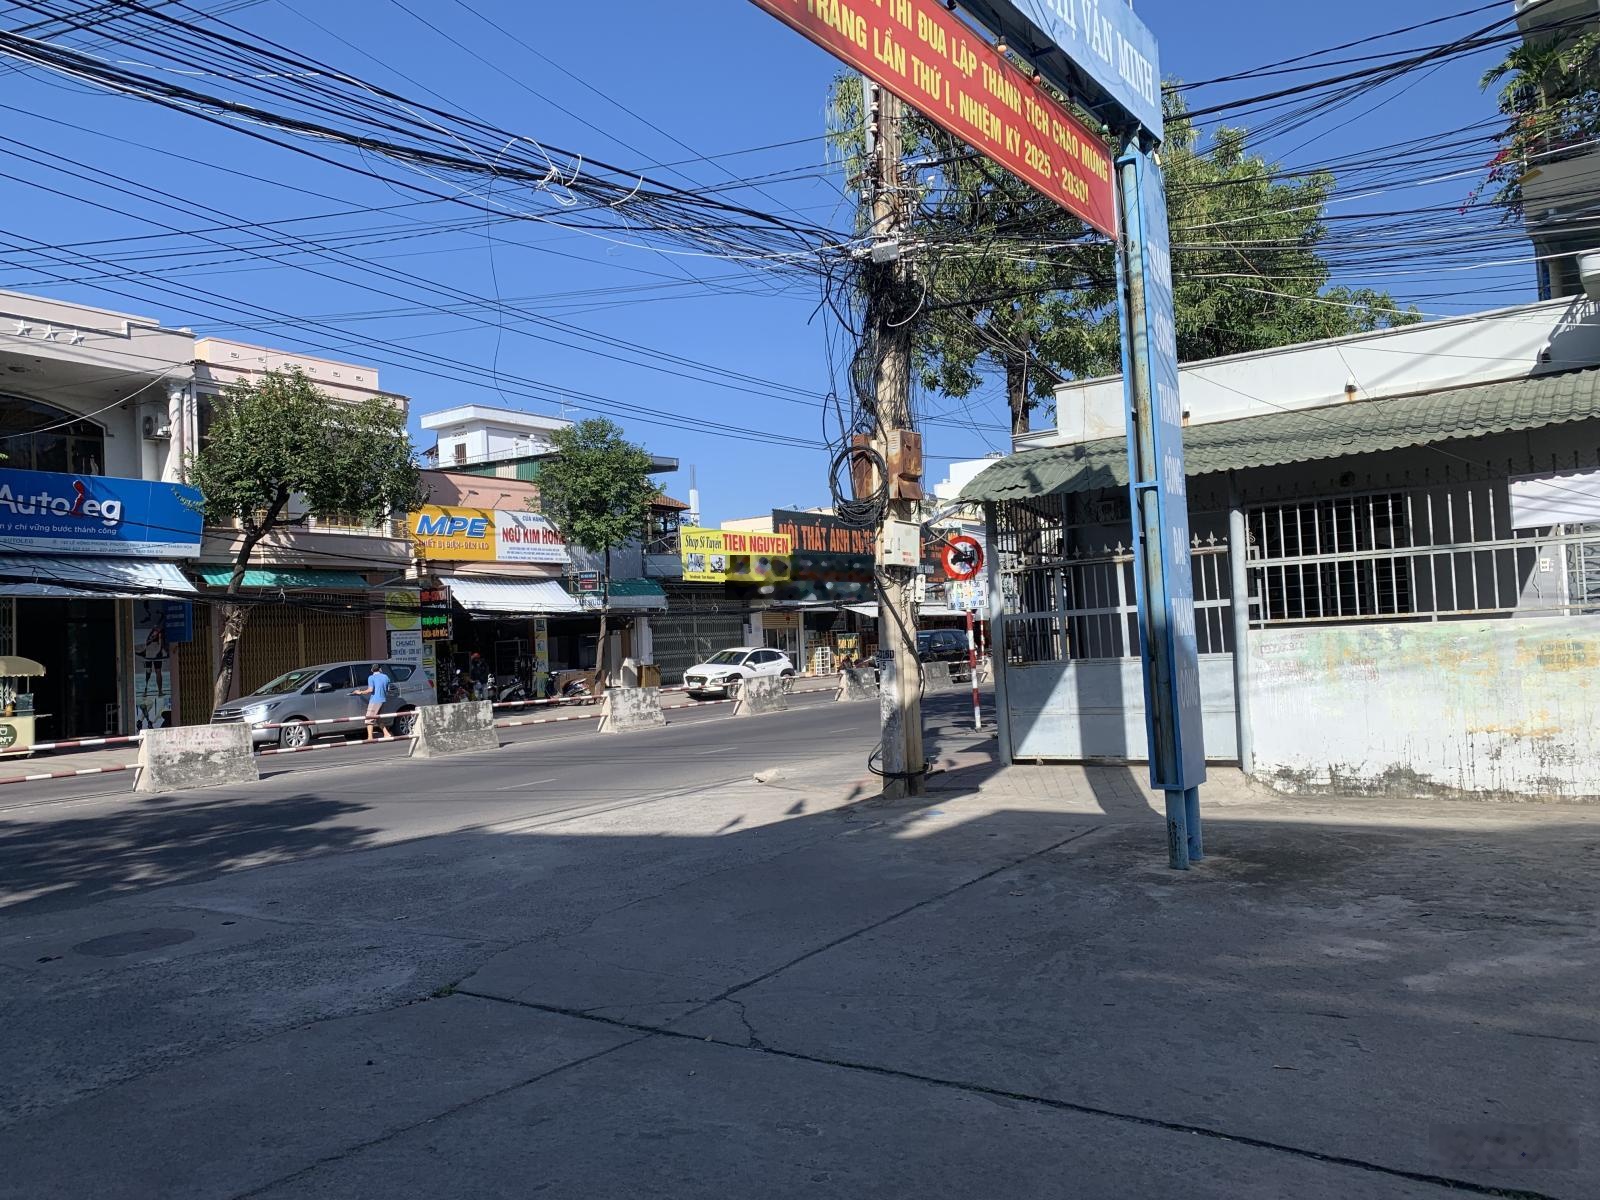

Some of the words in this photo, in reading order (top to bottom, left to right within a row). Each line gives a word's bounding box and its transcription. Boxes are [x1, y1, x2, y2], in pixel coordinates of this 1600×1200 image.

[917, 9, 948, 58] ĐUA
[951, 38, 978, 79] LẬP
[982, 61, 1022, 116] THÀNH
[1024, 94, 1050, 137] TÍCH
[1052, 119, 1079, 160] CHÀO
[1116, 31, 1155, 108] MINH
[873, 27, 906, 78] LẦN
[911, 54, 942, 101] THỨ
[959, 91, 1002, 145] NHIỆM
[1005, 124, 1021, 157] KỲ
[1024, 139, 1051, 179] 2025
[1061, 167, 1089, 206] 2030!
[416, 514, 489, 538] MPE
[501, 524, 521, 543] NGŨ
[523, 528, 540, 545] KIM
[800, 519, 827, 551] THẤT
[830, 523, 850, 552] ÁNH
[685, 534, 699, 550] Shop
[722, 533, 747, 552] TIEN
[749, 535, 789, 554] NGUYEN
